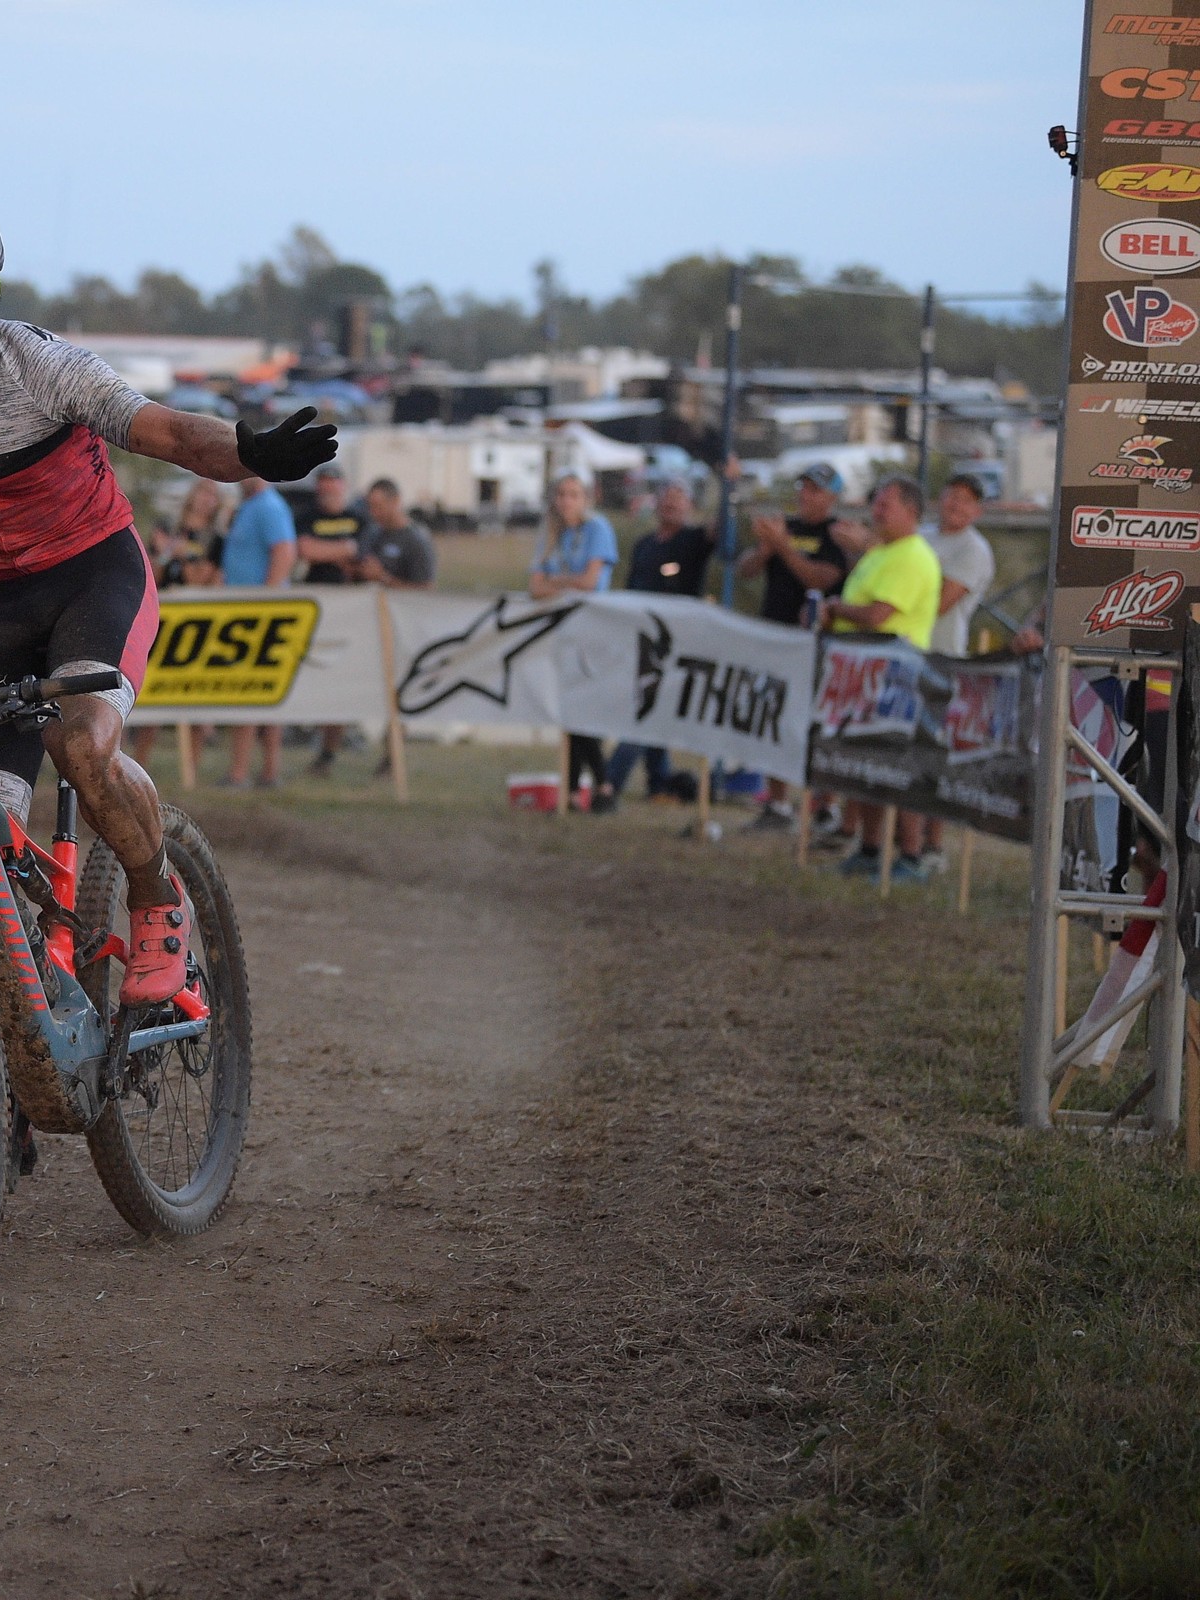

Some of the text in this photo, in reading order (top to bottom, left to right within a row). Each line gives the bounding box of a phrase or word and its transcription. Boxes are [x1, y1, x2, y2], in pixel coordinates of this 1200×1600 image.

[1154, 36, 1200, 46] RAC
[1119, 233, 1194, 257] BELL
[1104, 286, 1172, 344] VP
[1147, 319, 1194, 335] Racing
[1105, 360, 1200, 377] DUNLO
[1102, 374, 1200, 385] MOTORCYCLE TIRE
[1089, 463, 1193, 481] ALL BALLS
[1153, 478, 1192, 493] Racing
[1076, 513, 1198, 540] HOTCAMS
[676, 656, 787, 744] THOR
